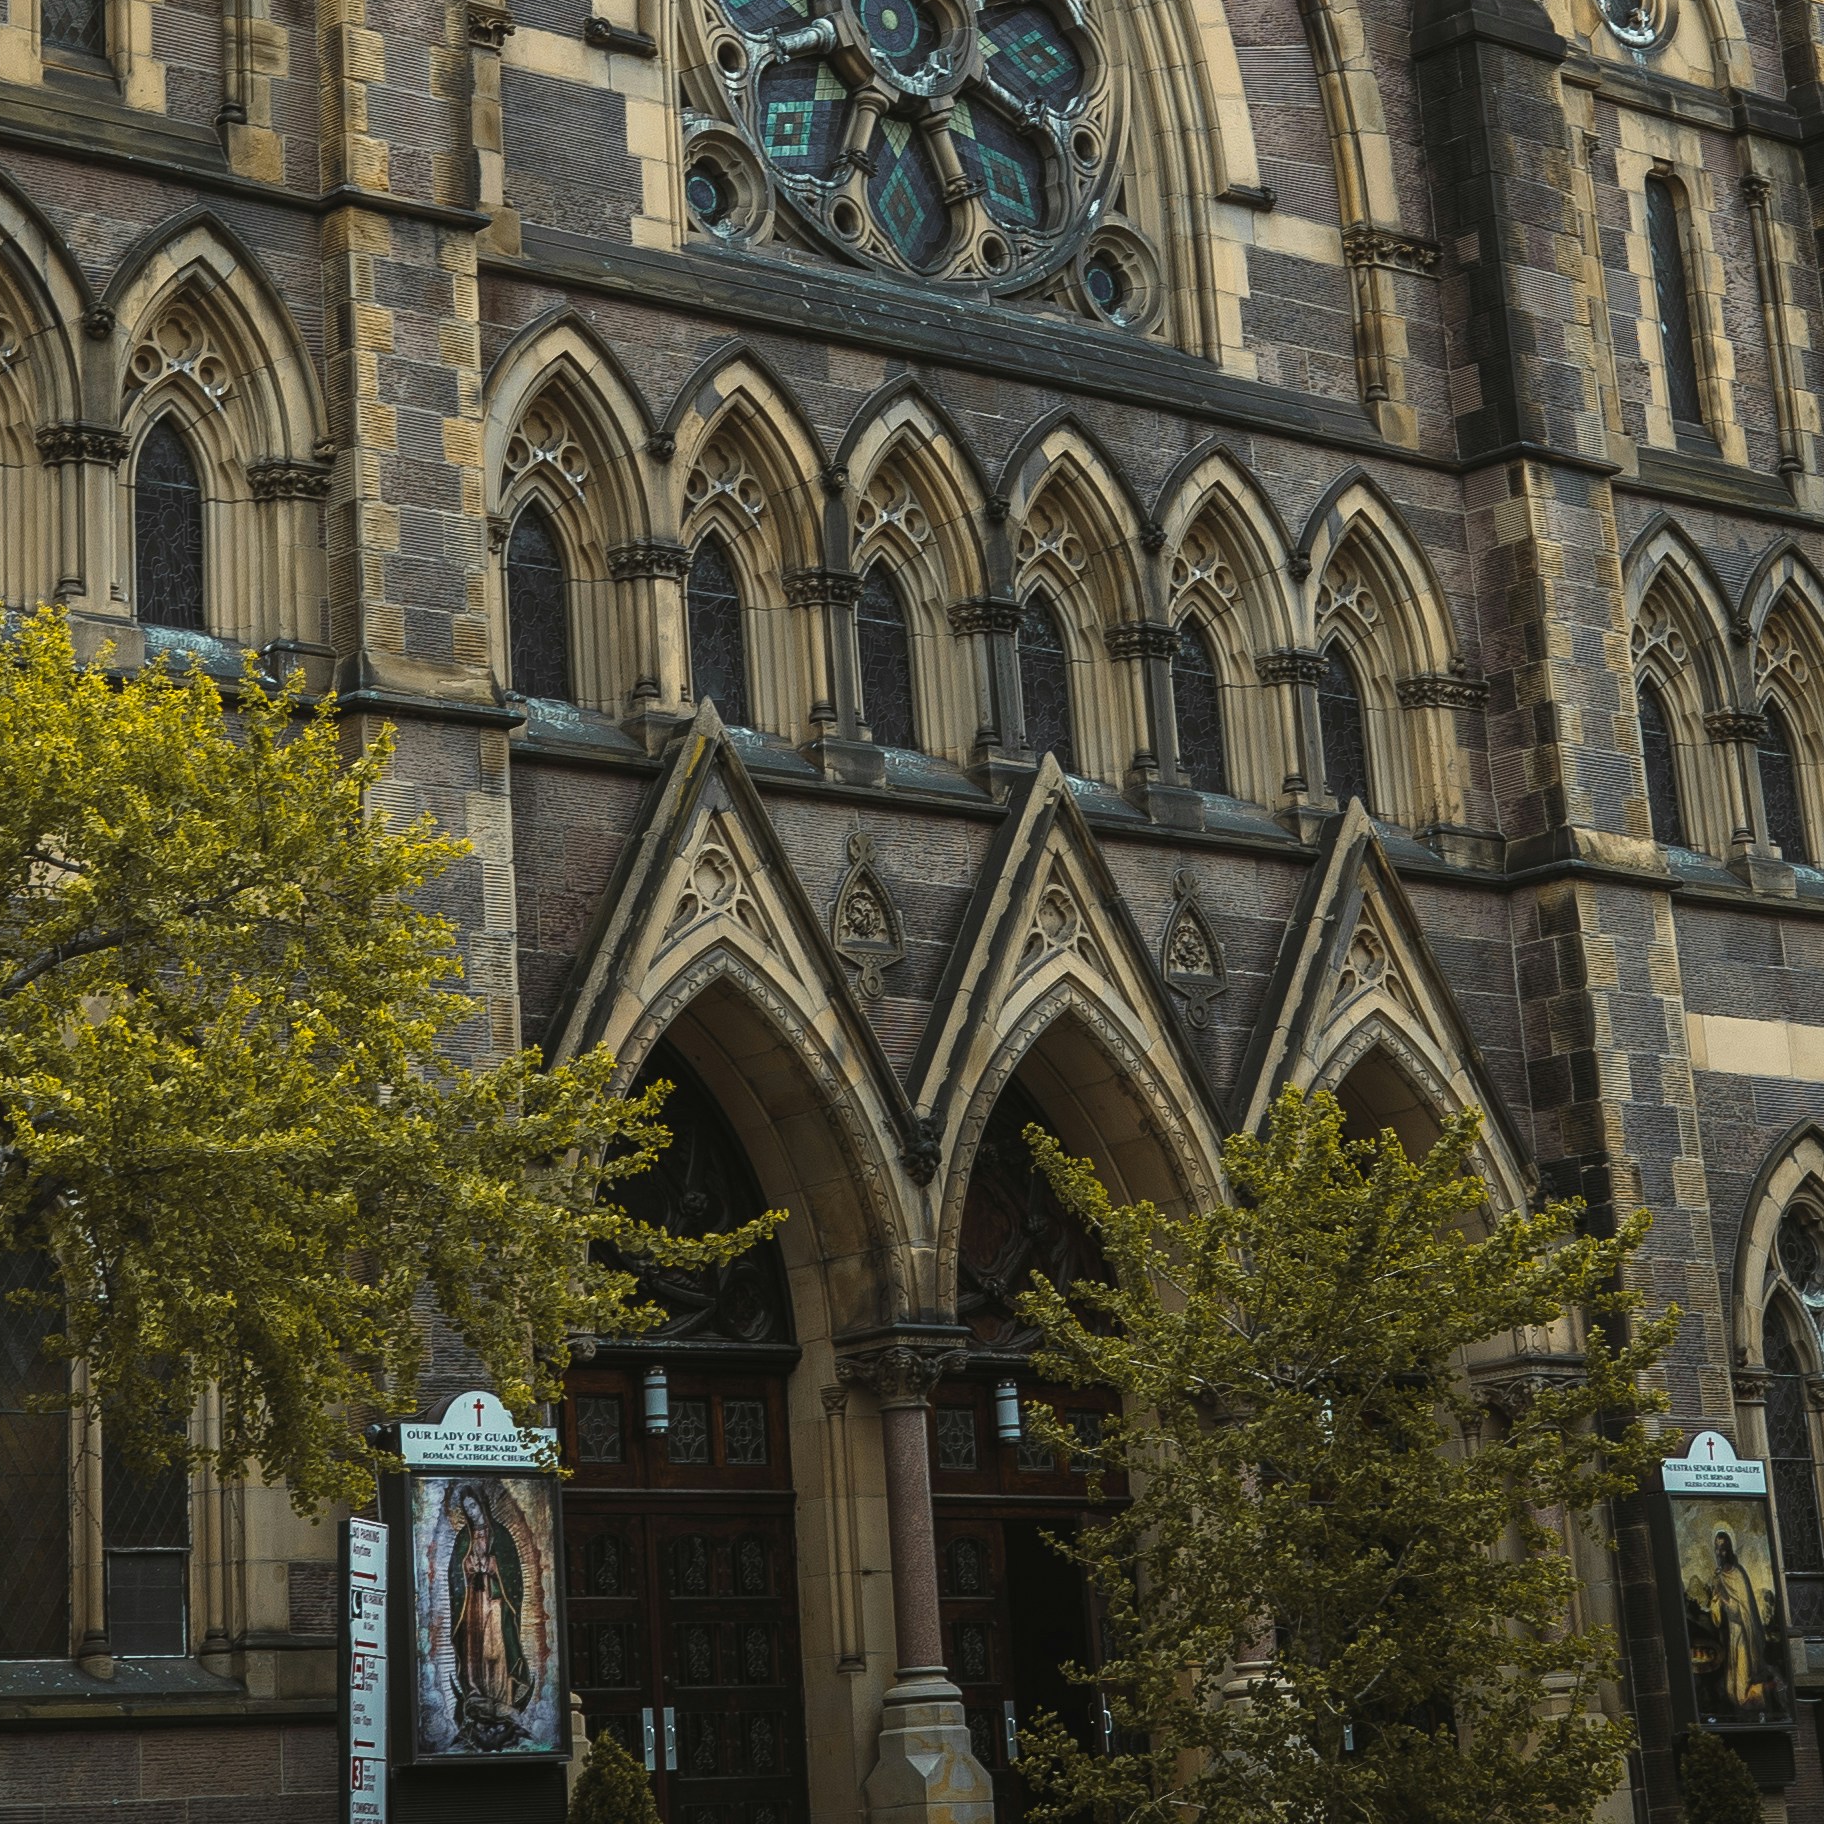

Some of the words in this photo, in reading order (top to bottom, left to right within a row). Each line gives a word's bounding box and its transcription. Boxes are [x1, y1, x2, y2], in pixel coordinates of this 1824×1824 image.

[407, 1430, 432, 1440] OUR
[434, 1431, 464, 1441] LADY
[467, 1433, 481, 1441] OF
[484, 1433, 551, 1443] GUADAPE
[474, 1444, 518, 1452] BERNARD
[422, 1452, 455, 1460] ROMAN
[456, 1453, 500, 1461] CATHOLIC
[501, 1455, 534, 1463] CHURC
[1726, 1465, 1761, 1473] GUADALUPE
[360, 1528, 380, 1544] PARKING
[353, 1542, 372, 1558] Anytime
[354, 1759, 361, 1788] 3
